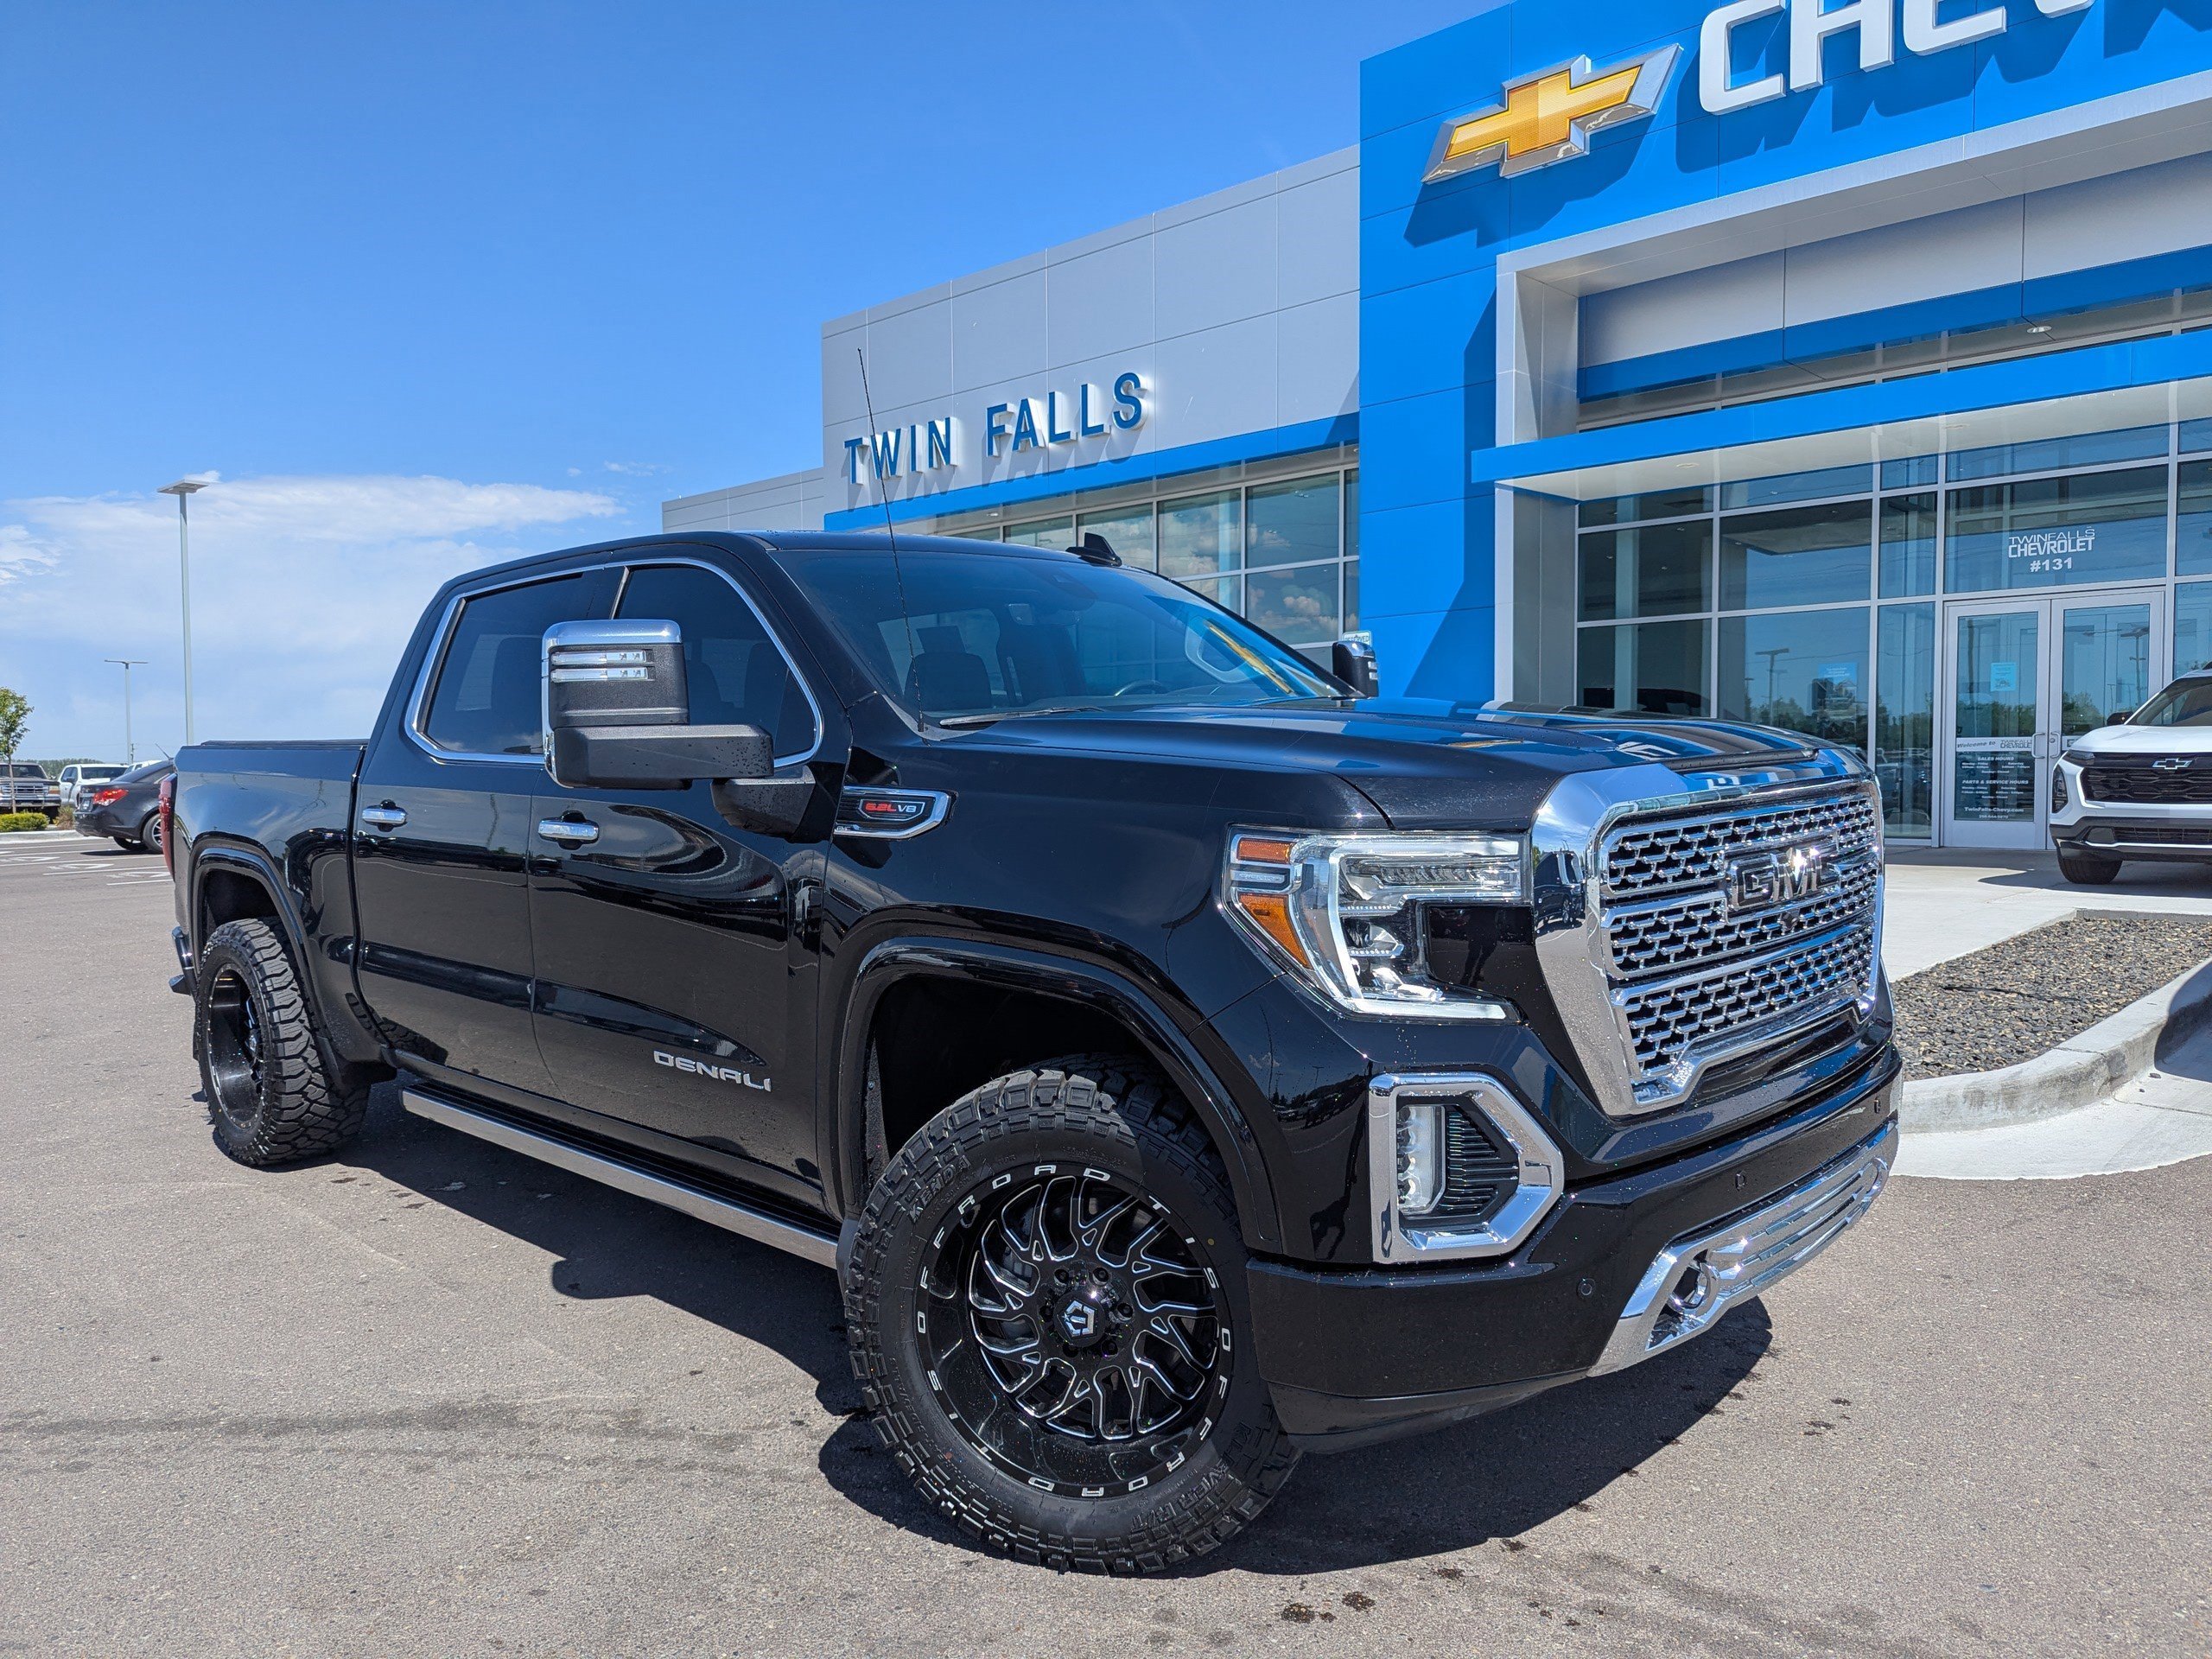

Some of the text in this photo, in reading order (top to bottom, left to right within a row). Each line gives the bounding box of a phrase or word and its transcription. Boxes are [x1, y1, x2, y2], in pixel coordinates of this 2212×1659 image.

[1700, 0, 2094, 115] CH
[844, 372, 1148, 485] TWIN FALLS
[2008, 537, 2095, 558] CHEVROLET
[2030, 557, 2072, 572] #131
[1729, 848, 1841, 907] GMC
[653, 1050, 772, 1092] DENALI
